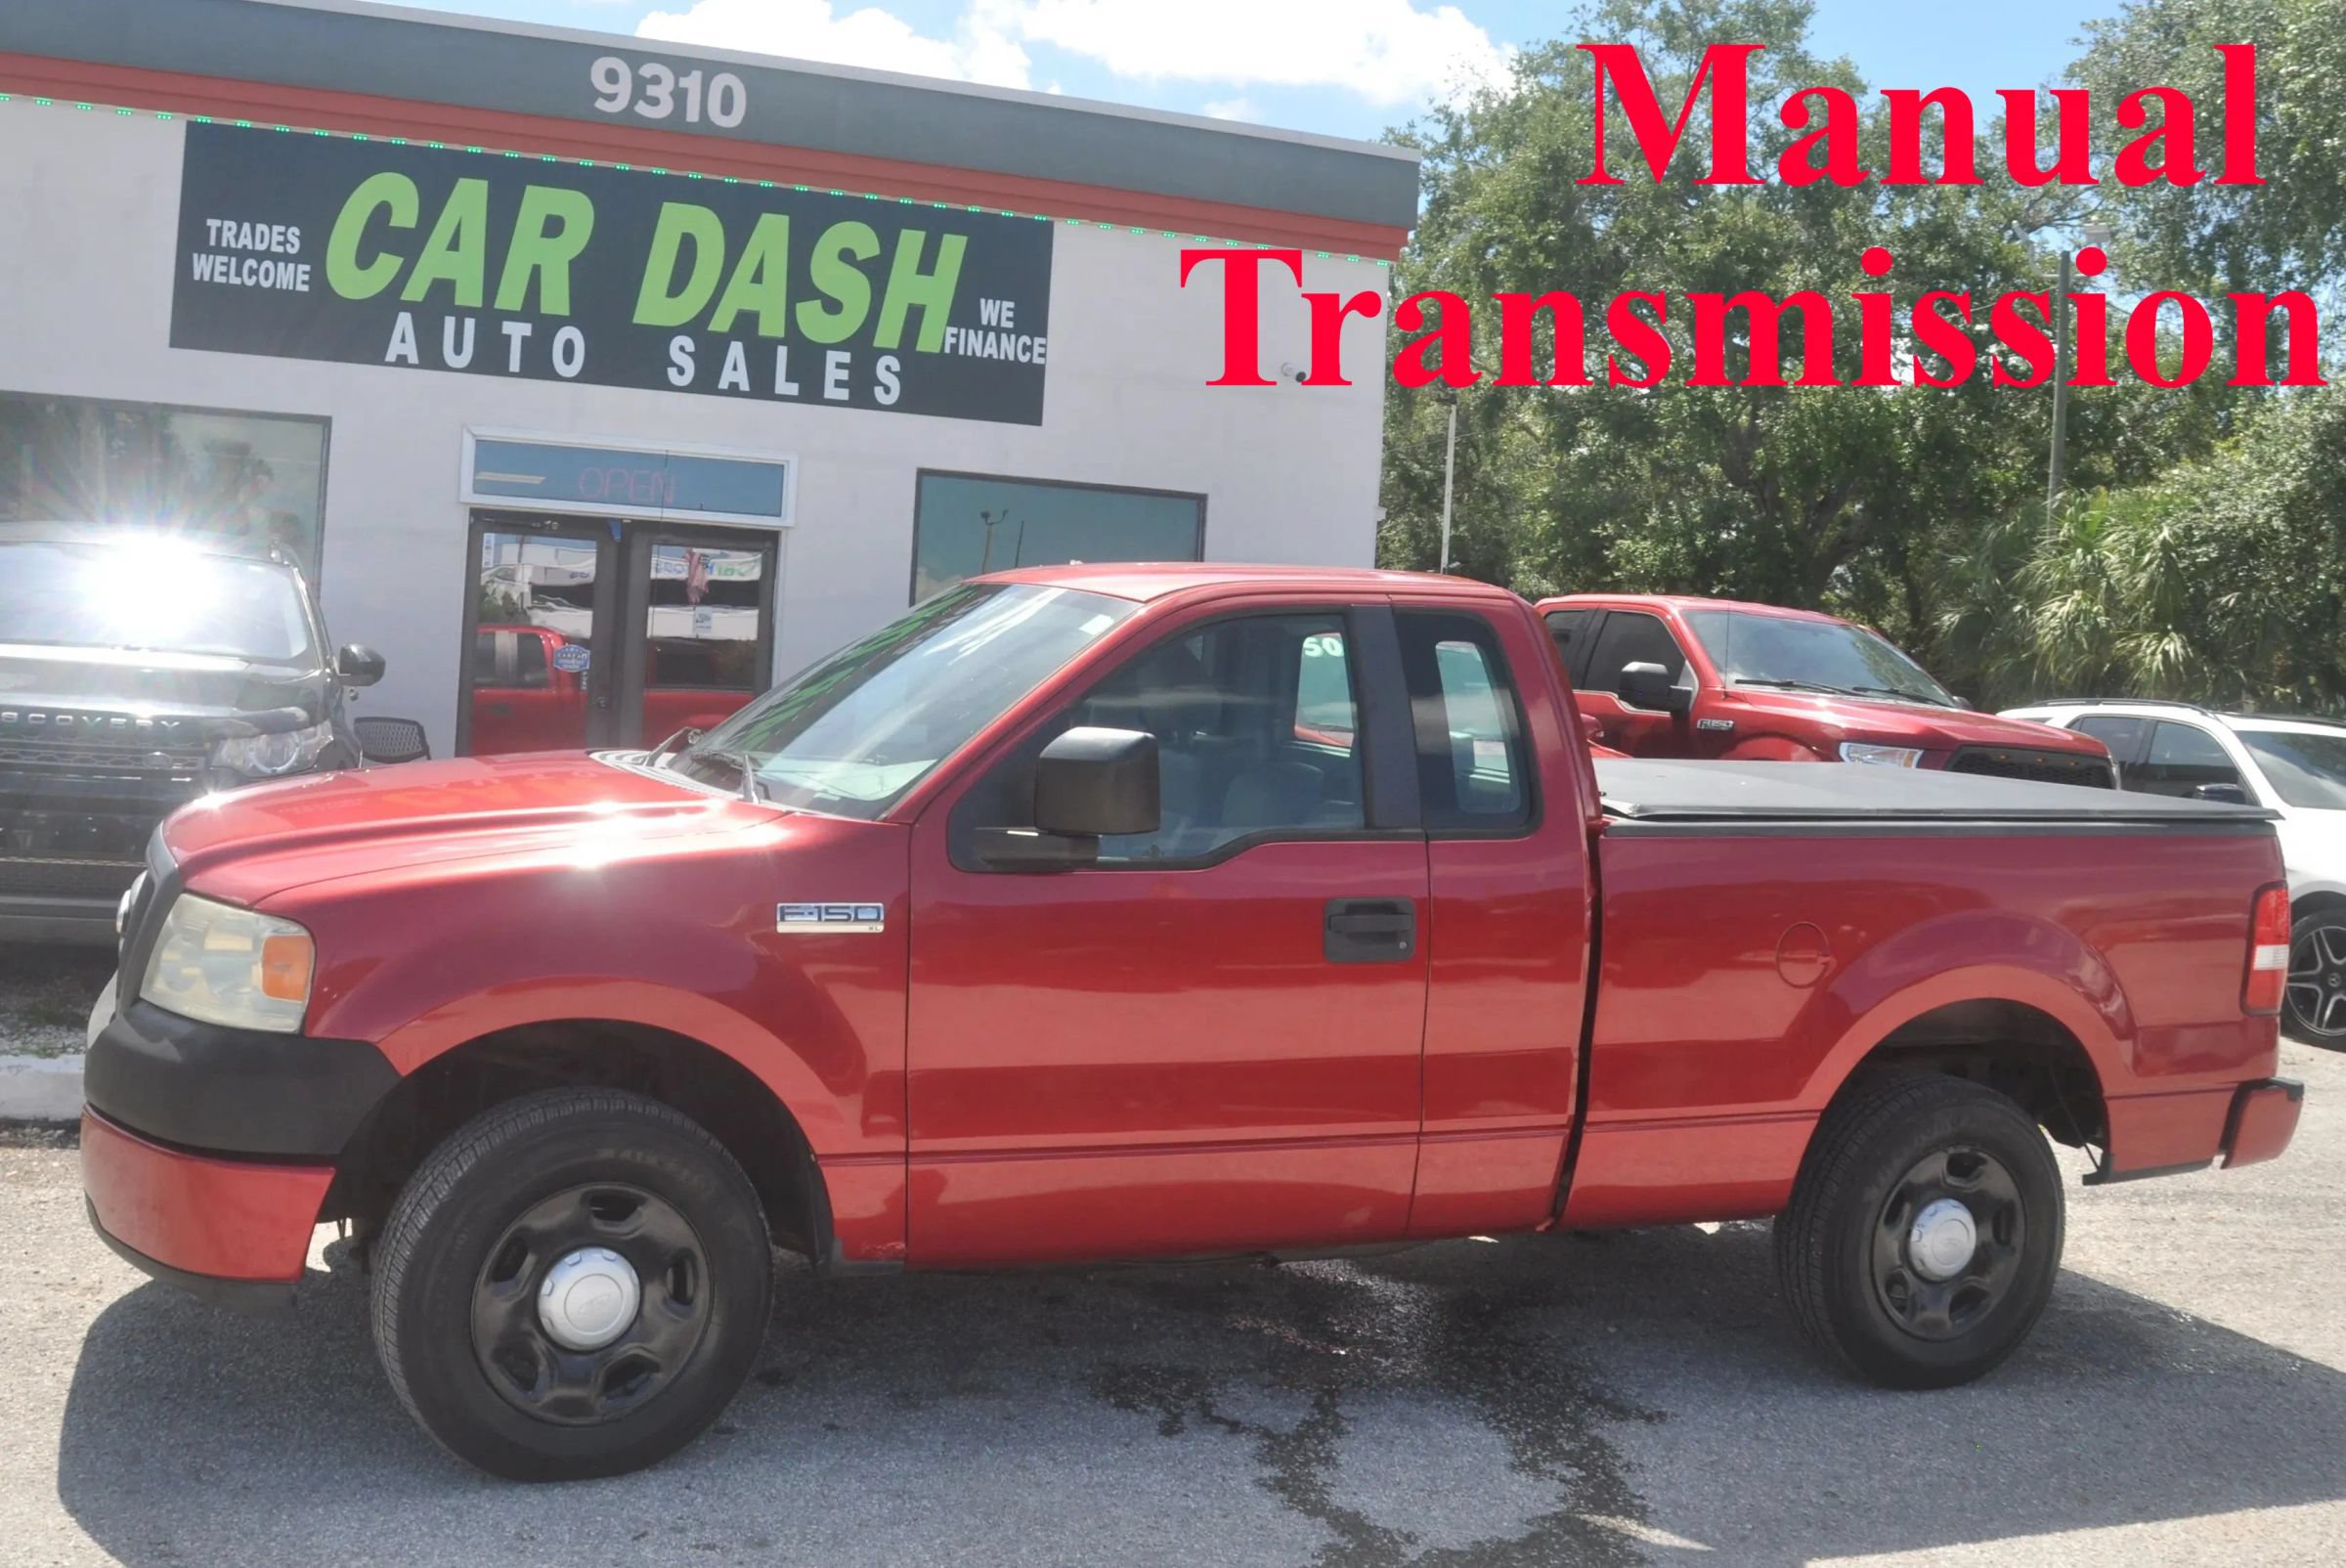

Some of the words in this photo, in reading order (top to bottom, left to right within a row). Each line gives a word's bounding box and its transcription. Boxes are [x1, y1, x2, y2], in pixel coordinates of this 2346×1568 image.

[590, 57, 747, 128] 9310
[206, 218, 300, 254] TRADES
[193, 253, 311, 292] WELCOME
[326, 172, 594, 316] CAR
[632, 201, 969, 354] DASH
[980, 297, 1015, 328] WE
[384, 311, 586, 378] AUTO
[667, 335, 901, 405] SALES
[944, 327, 1047, 365] FINANCE
[578, 466, 677, 504] OPEN
[779, 905, 881, 923] F-150
